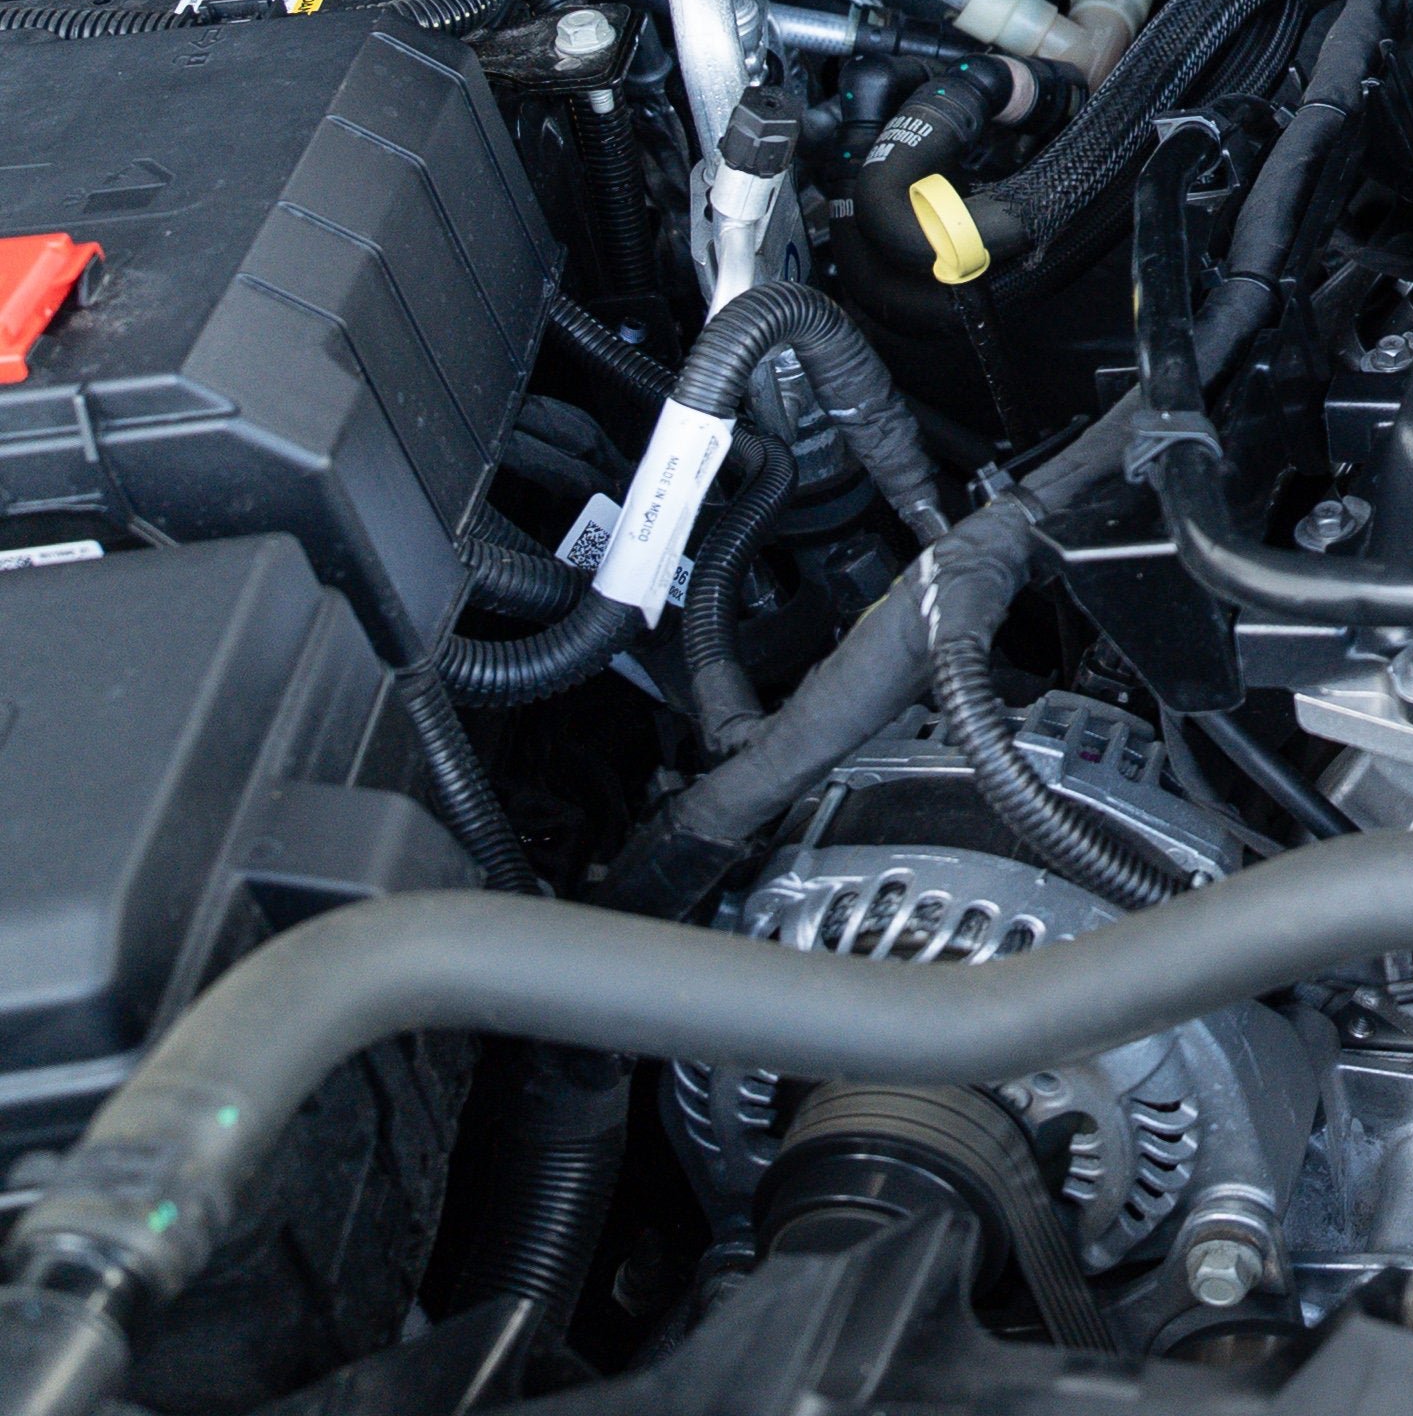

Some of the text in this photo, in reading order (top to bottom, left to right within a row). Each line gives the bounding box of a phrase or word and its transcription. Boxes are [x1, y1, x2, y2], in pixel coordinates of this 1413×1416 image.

[638, 455, 680, 543] MADE IN MEXICO
